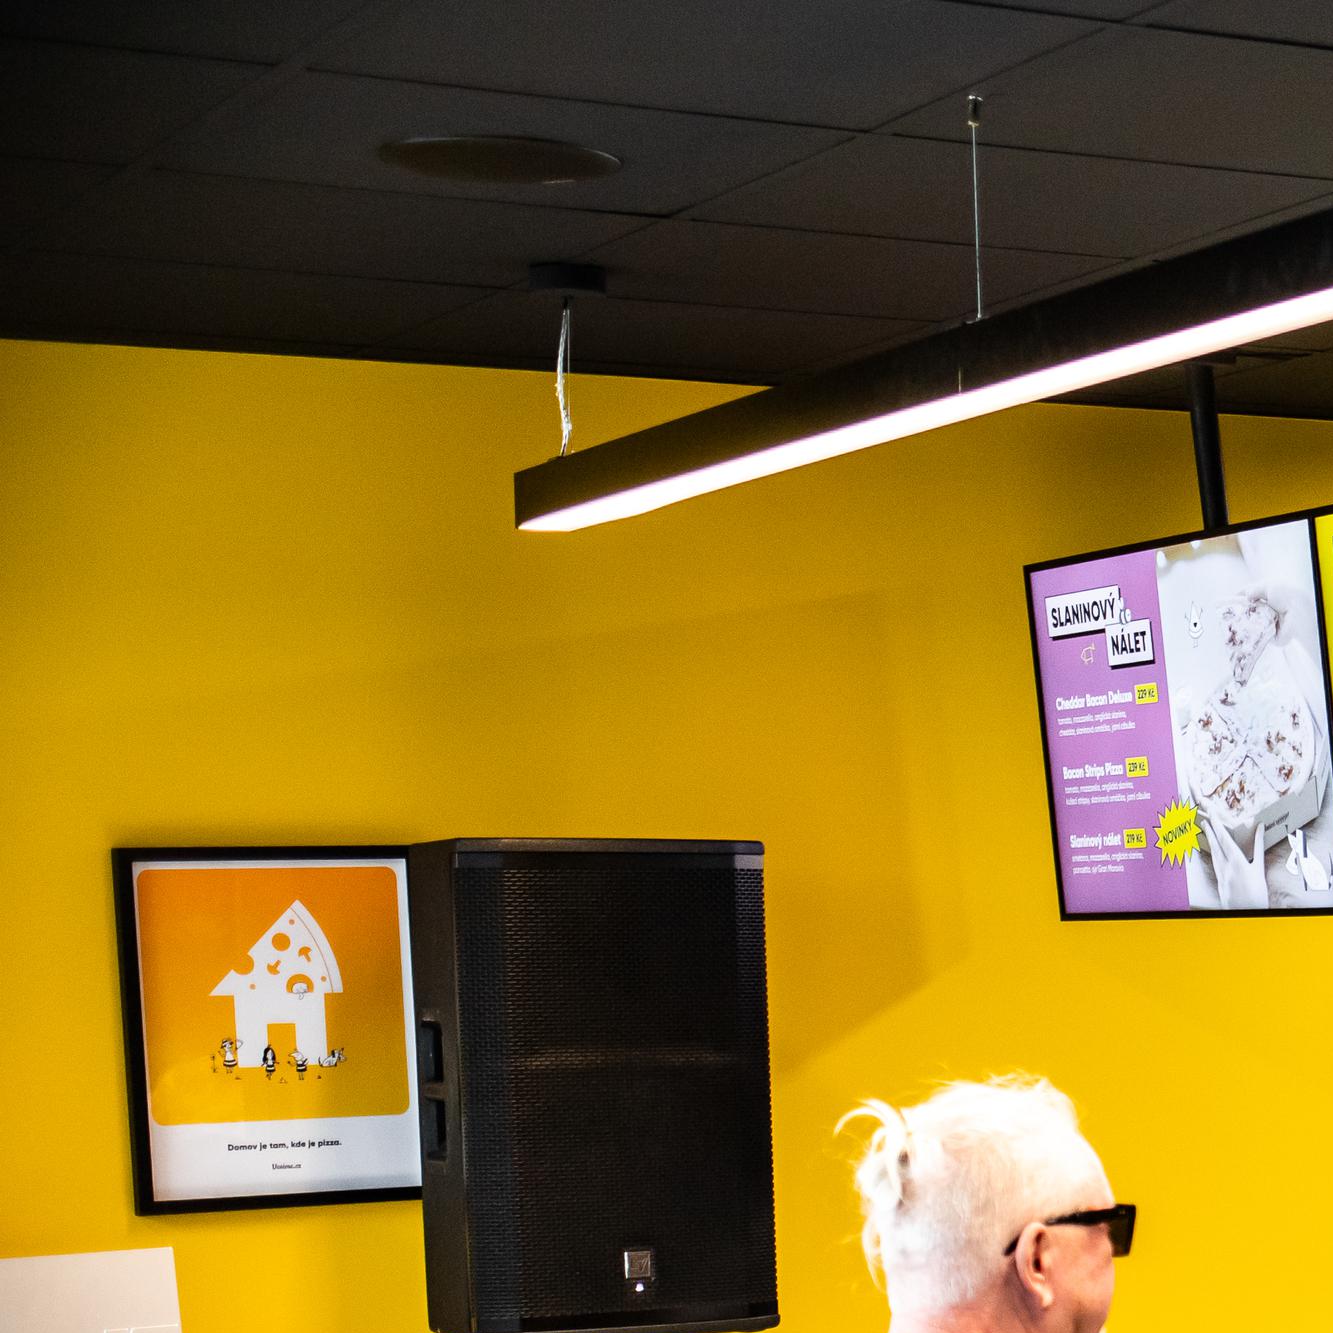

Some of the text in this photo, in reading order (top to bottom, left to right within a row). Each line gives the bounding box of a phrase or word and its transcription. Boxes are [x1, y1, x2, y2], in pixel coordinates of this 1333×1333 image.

[1052, 593, 1115, 628] SLANINOVÝ
[1111, 629, 1146, 656] NÁLET
[1163, 819, 1192, 846] NOVINKY
[228, 1139, 342, 1151] Domov je tam, kde je pizza.
